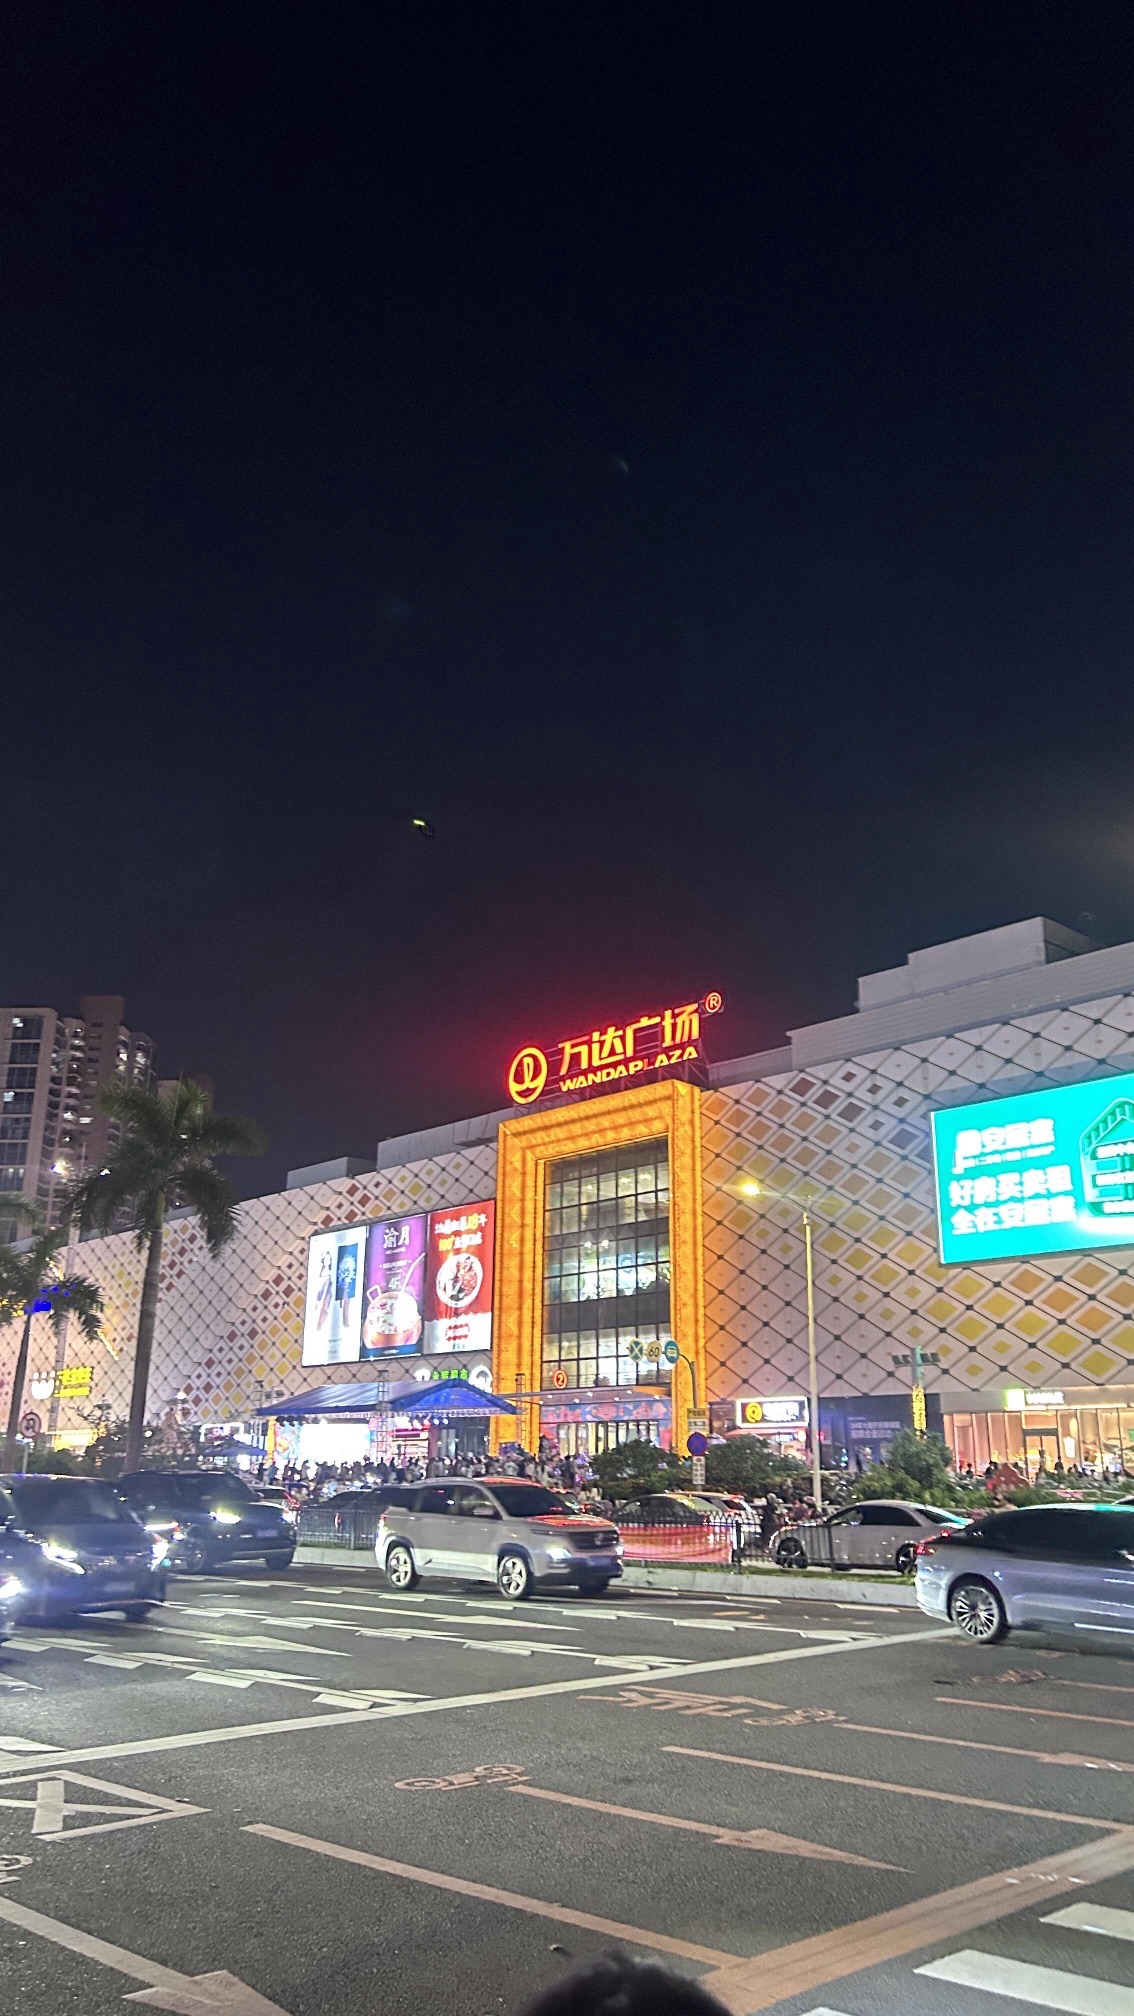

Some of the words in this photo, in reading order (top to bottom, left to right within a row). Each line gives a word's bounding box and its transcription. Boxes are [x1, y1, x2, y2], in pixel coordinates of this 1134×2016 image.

[558, 1003, 700, 1076] 万达广场
[558, 1065, 628, 1092] WANDA
[628, 1045, 699, 1075] PLAZA
[648, 1347, 660, 1357] 60
[556, 1372, 564, 1386] 2
